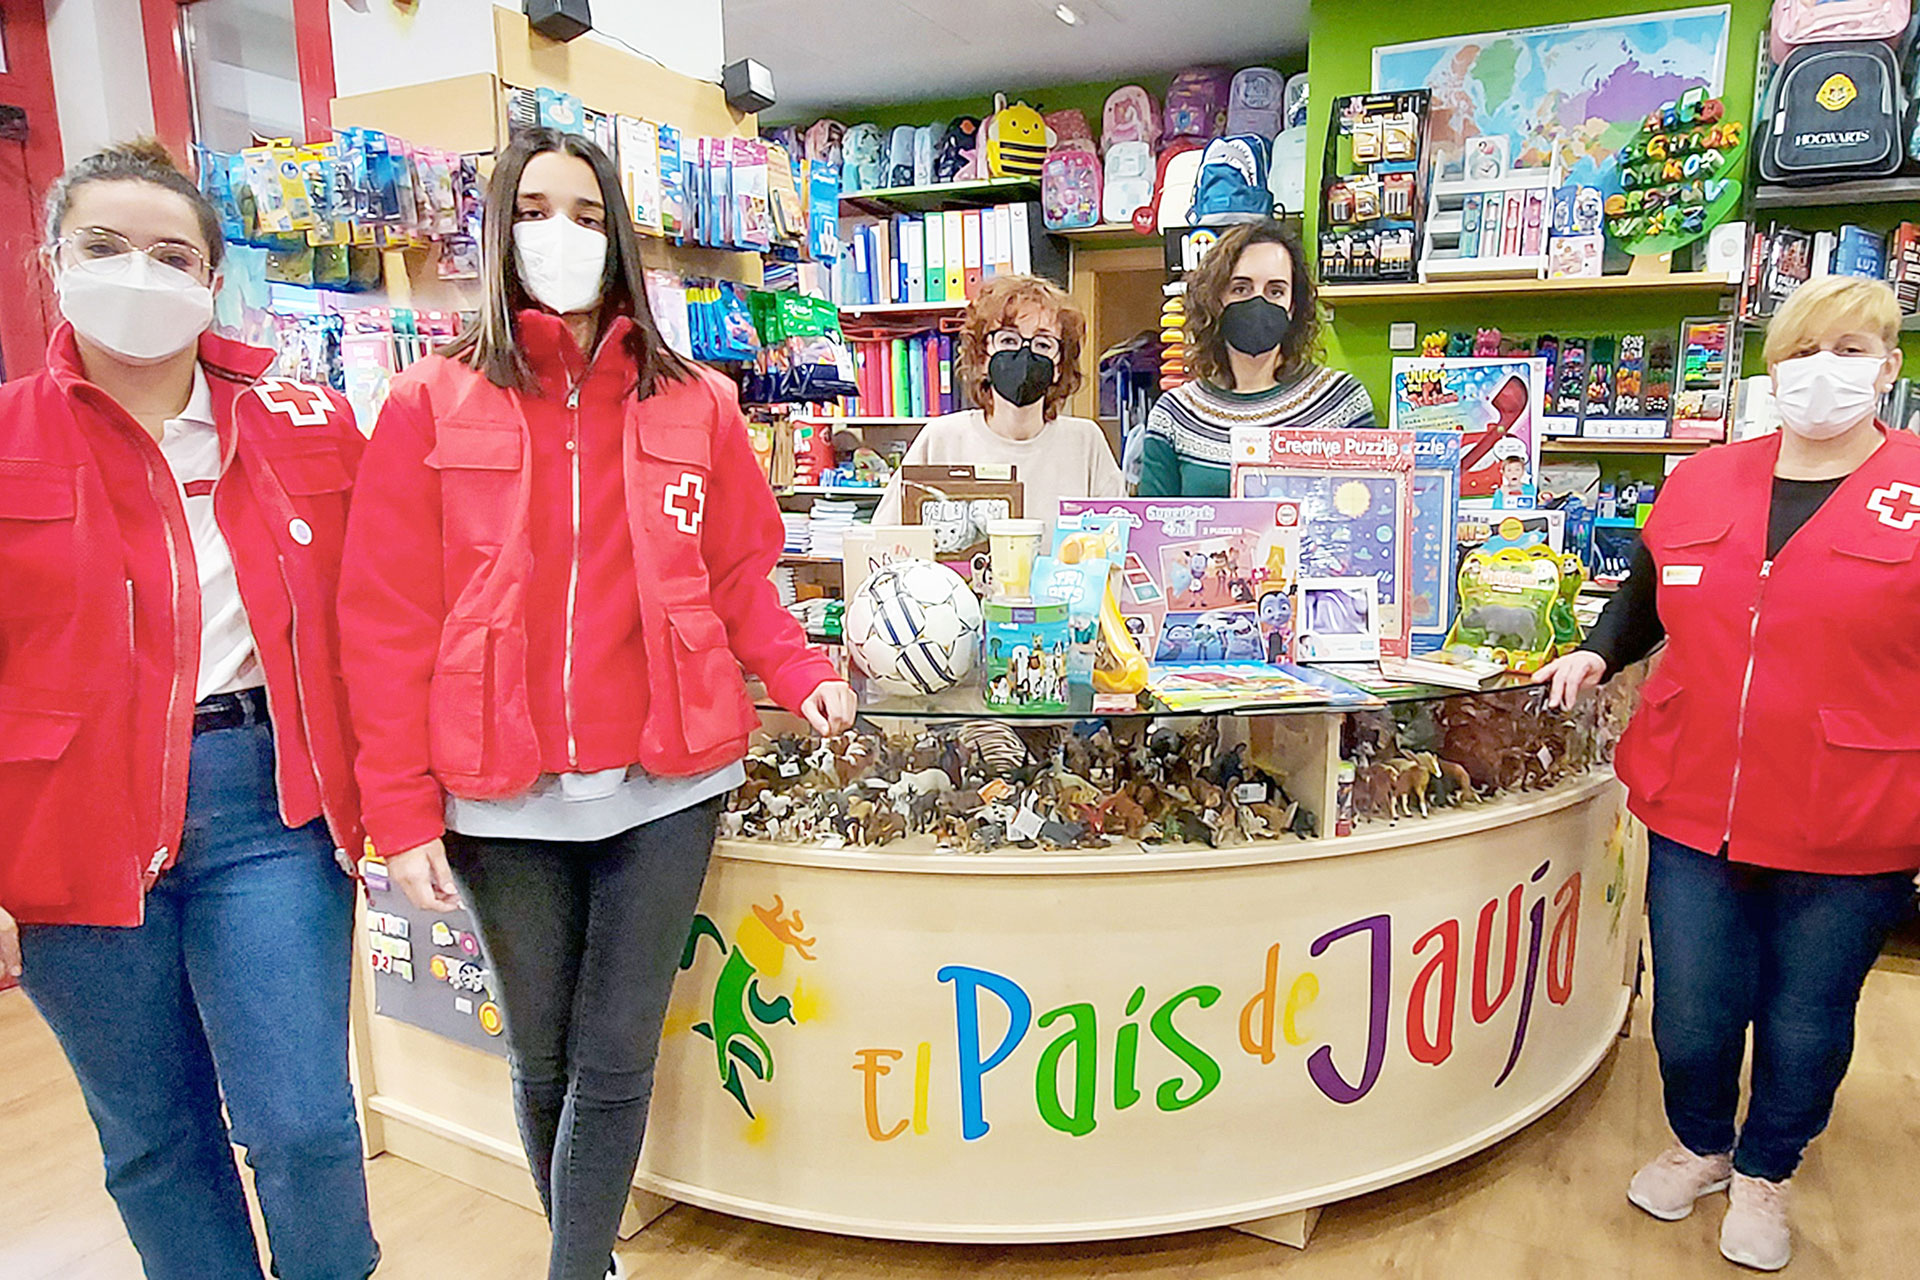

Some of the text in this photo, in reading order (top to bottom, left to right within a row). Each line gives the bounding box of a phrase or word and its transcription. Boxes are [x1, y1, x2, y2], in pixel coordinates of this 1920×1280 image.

[1795, 130, 1870, 146] HOGWARTS
[1274, 437, 1399, 457] Creative Puzzle
[854, 859, 1582, 1143] El País de Jauja
